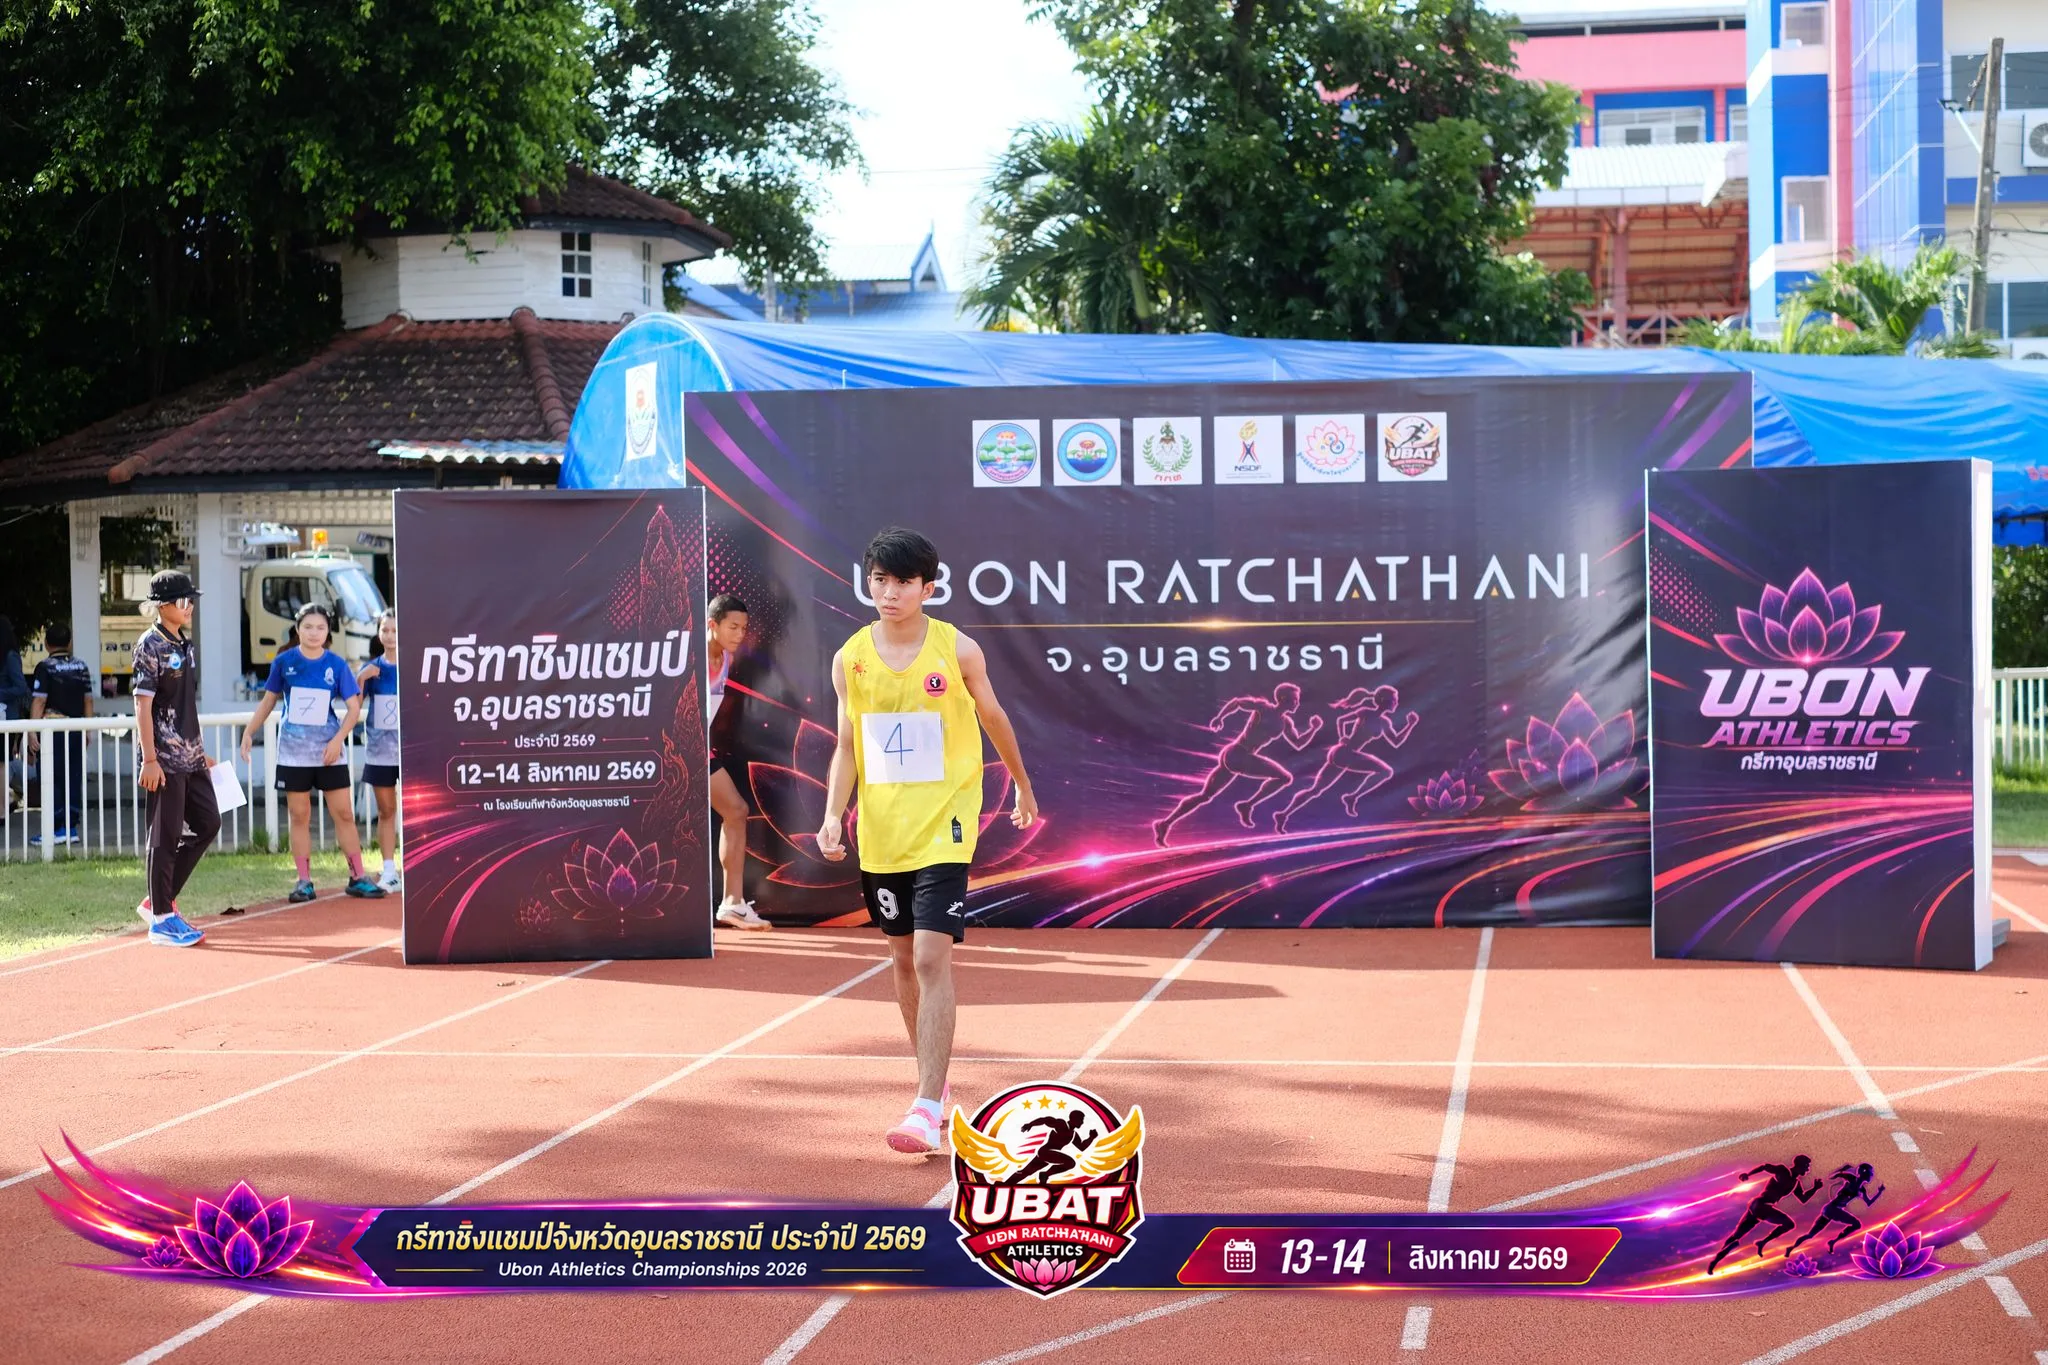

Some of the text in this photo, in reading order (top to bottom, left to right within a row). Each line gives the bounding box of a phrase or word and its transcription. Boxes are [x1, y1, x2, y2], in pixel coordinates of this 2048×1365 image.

[1389, 446, 1437, 461] UBAT
[1107, 552, 1590, 604] RATCHATHANI
[421, 630, 690, 683] กรีฑาชิงแชมป์
[1047, 633, 1384, 685] จ.อุบลราชธานี
[297, 696, 317, 717] 7
[453, 683, 652, 731] จ.อุบลราชธานี
[1700, 667, 1932, 717] UBON
[385, 699, 397, 726] 8
[514, 733, 596, 749] ประจำปี 2569
[884, 722, 914, 766] 4
[1700, 720, 1924, 748] ATHLETICS
[527, 761, 601, 783] สิงหาคม
[607, 760, 656, 780] 2569
[483, 801, 494, 811] ณ
[877, 887, 900, 921] 9
